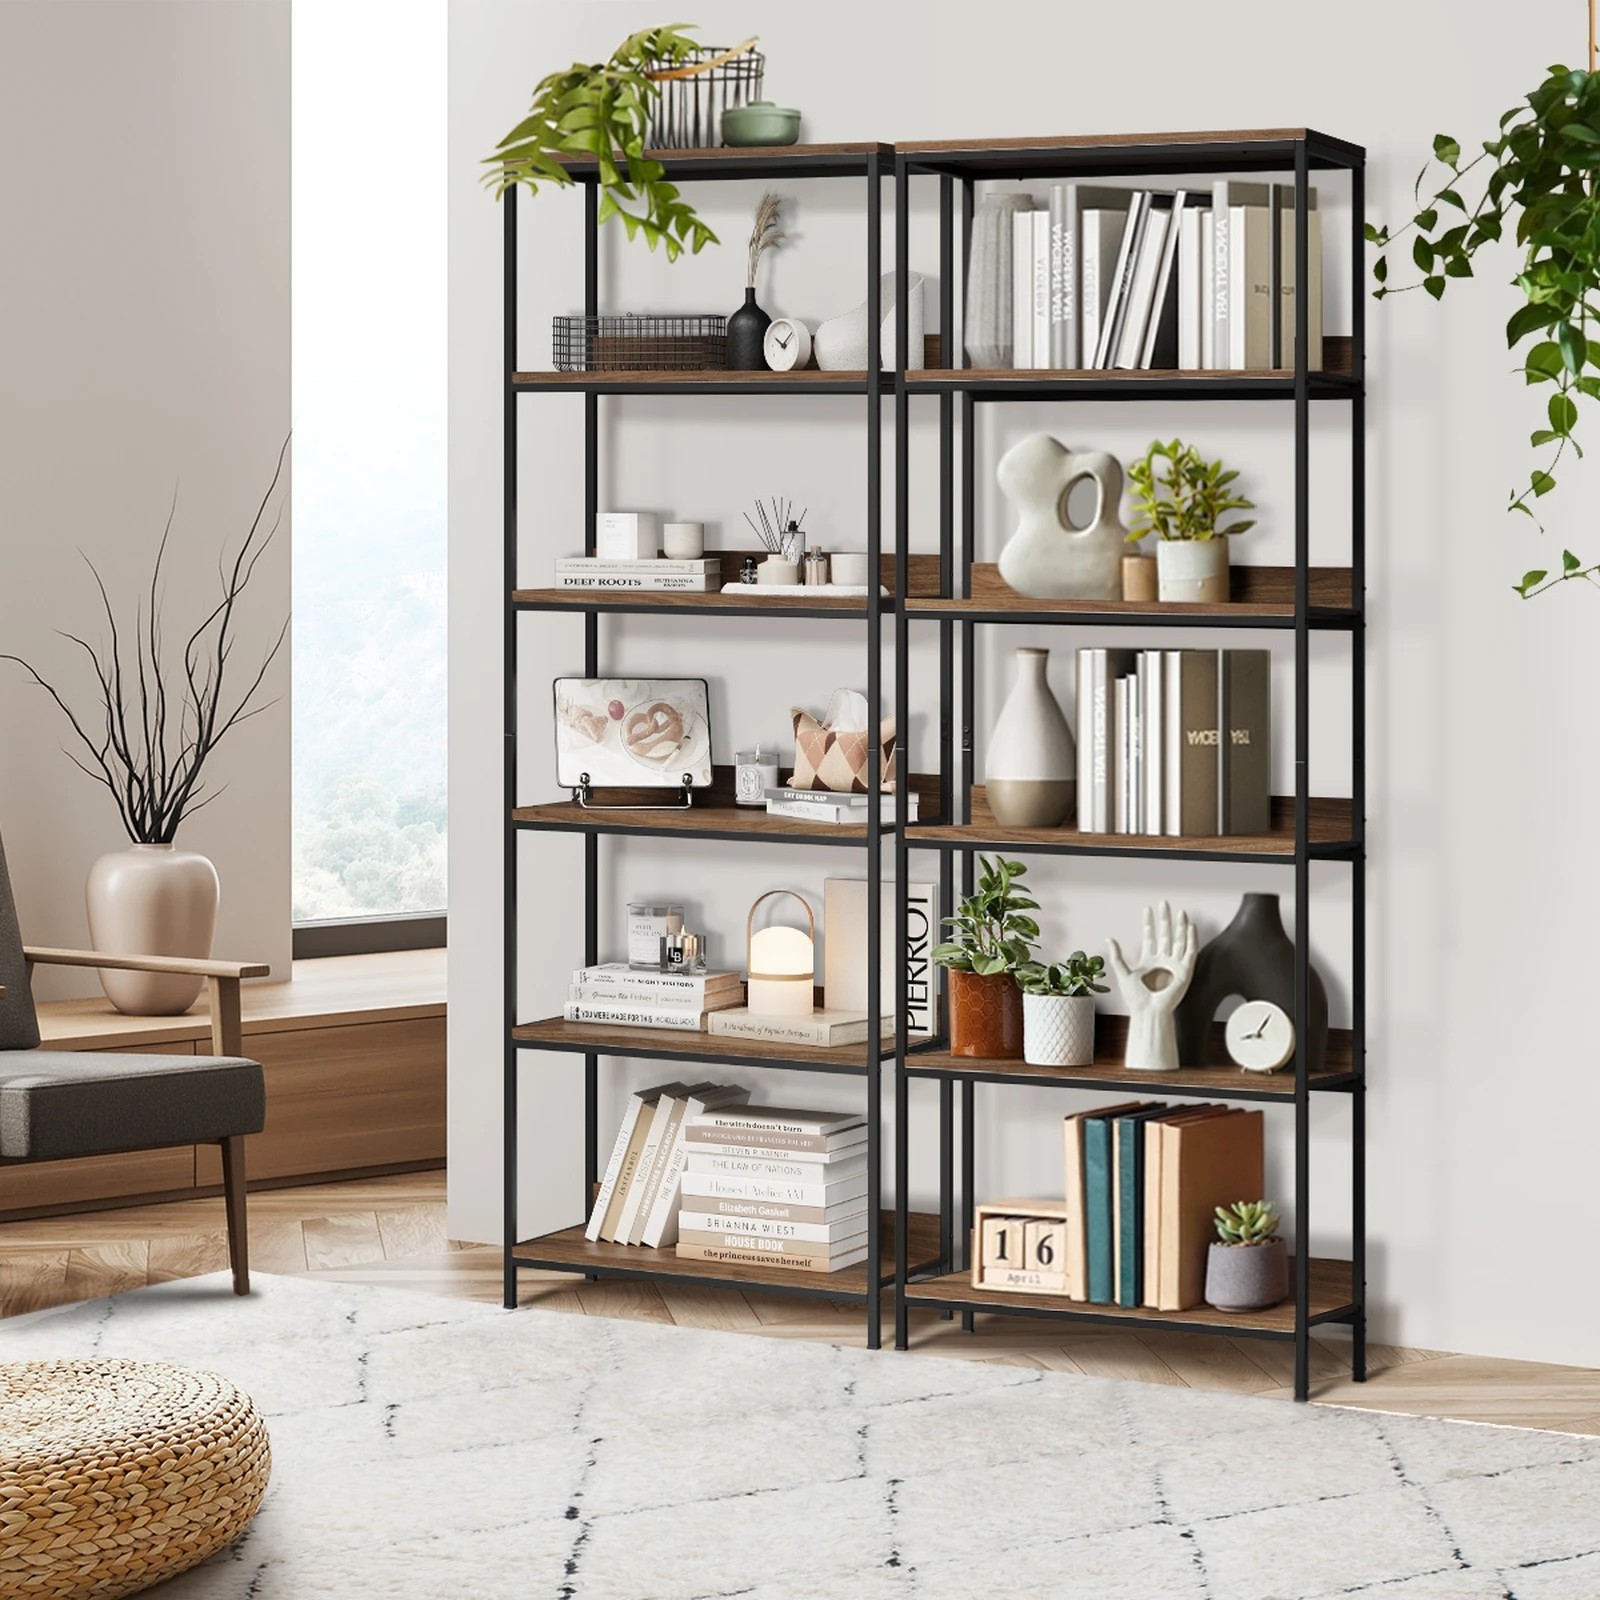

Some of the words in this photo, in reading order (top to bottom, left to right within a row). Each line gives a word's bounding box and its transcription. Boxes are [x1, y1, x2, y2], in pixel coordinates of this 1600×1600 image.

[563, 578, 596, 586] DEEP
[598, 578, 642, 586] ROOTS
[581, 1010, 593, 1019] YOU
[593, 1011, 610, 1020] WERE
[611, 1012, 627, 1021] MADE
[628, 1013, 640, 1022] FOR
[712, 1160, 728, 1170] THE
[731, 1161, 750, 1171] LAW
[752, 1163, 761, 1172] OF
[765, 1165, 803, 1176] NATIONS
[719, 1202, 757, 1215] Elizabeth
[758, 1206, 789, 1218] Gaskell
[707, 1218, 757, 1232] BRIANNA
[762, 1223, 796, 1236] WIEST
[724, 1235, 756, 1250] HOUSE
[758, 1239, 785, 1252] BOOK
[781, 1257, 812, 1268] herself
[1007, 1272, 1041, 1284] April
